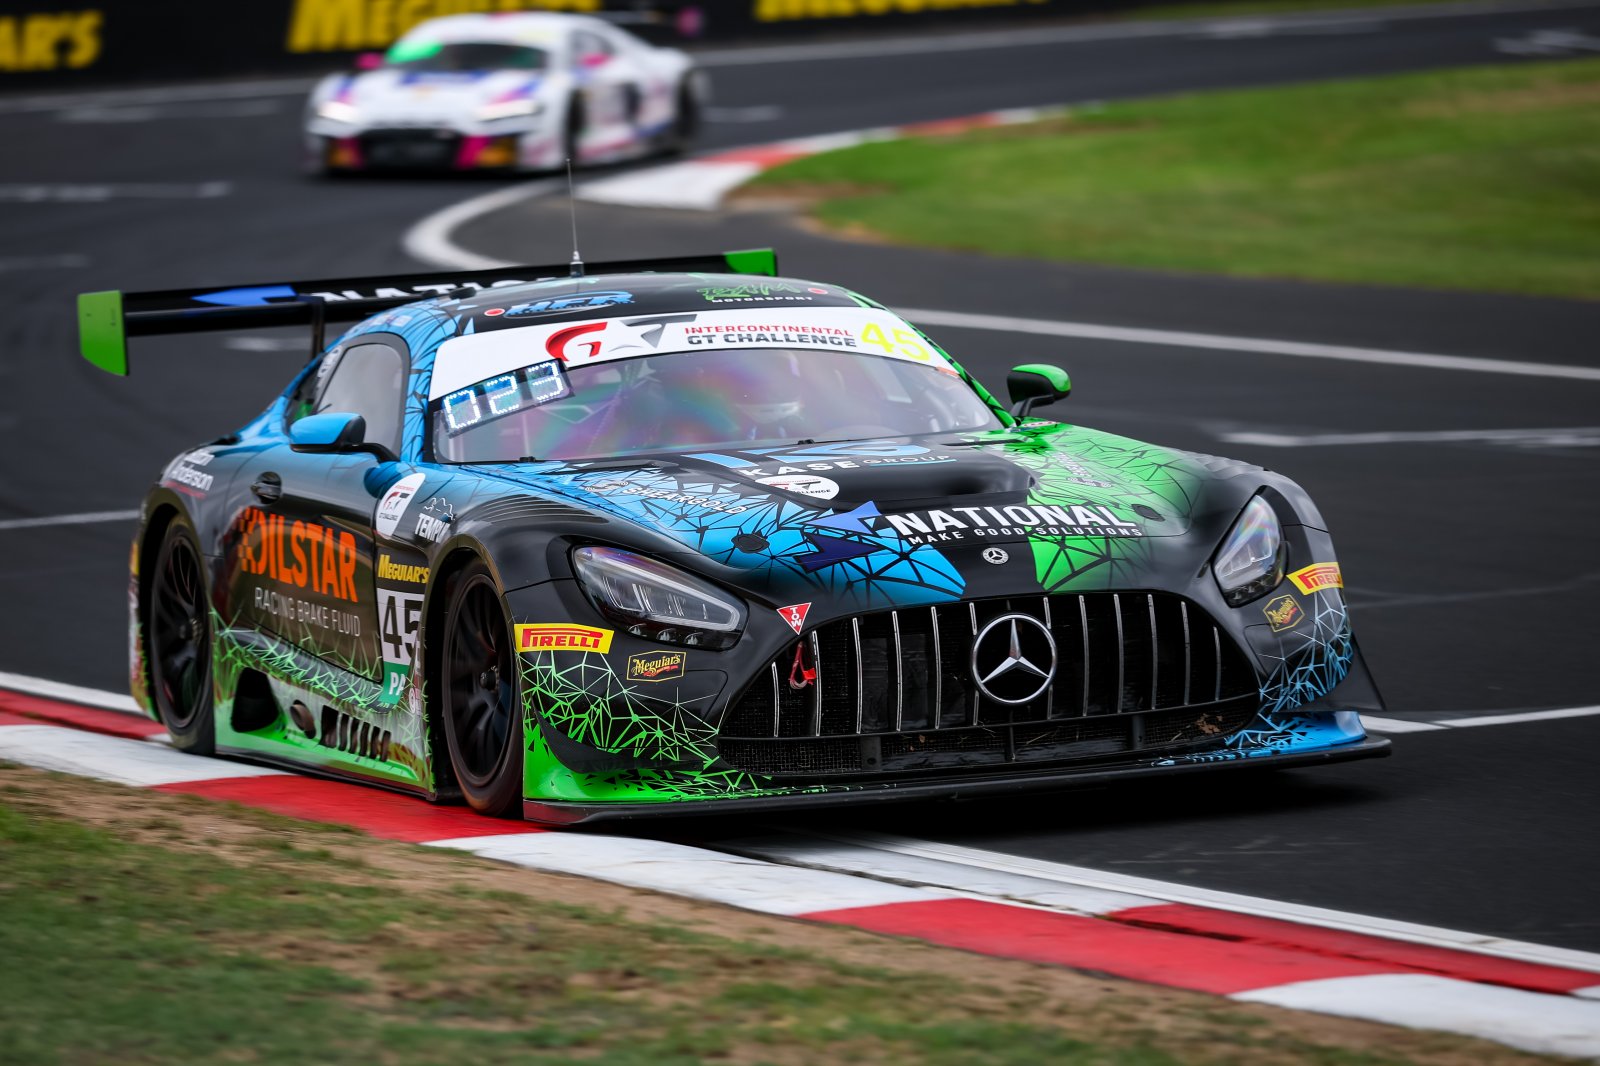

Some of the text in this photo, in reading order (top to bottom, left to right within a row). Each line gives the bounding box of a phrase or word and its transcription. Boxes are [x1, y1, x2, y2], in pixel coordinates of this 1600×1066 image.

[684, 325, 854, 337] INTERCONTINENTAL
[687, 332, 857, 348] GT CHALLENGE
[859, 322, 931, 362] 45
[443, 361, 564, 430] 023
[736, 455, 951, 477] KASE GROUP
[621, 487, 748, 514] SHEARGOLD
[885, 505, 1137, 536] NATIONAL
[907, 526, 1143, 545] MAKE GOOD SOLUTIONS
[238, 505, 359, 603] OILSTAR
[377, 553, 431, 584] MEGUIAR'S
[254, 586, 361, 637] RACING BRAKE FLUID
[790, 606, 802, 628] TOW
[382, 595, 424, 659] 45
[521, 627, 604, 649] PIRELLI
[630, 653, 682, 677] Meguiar's
